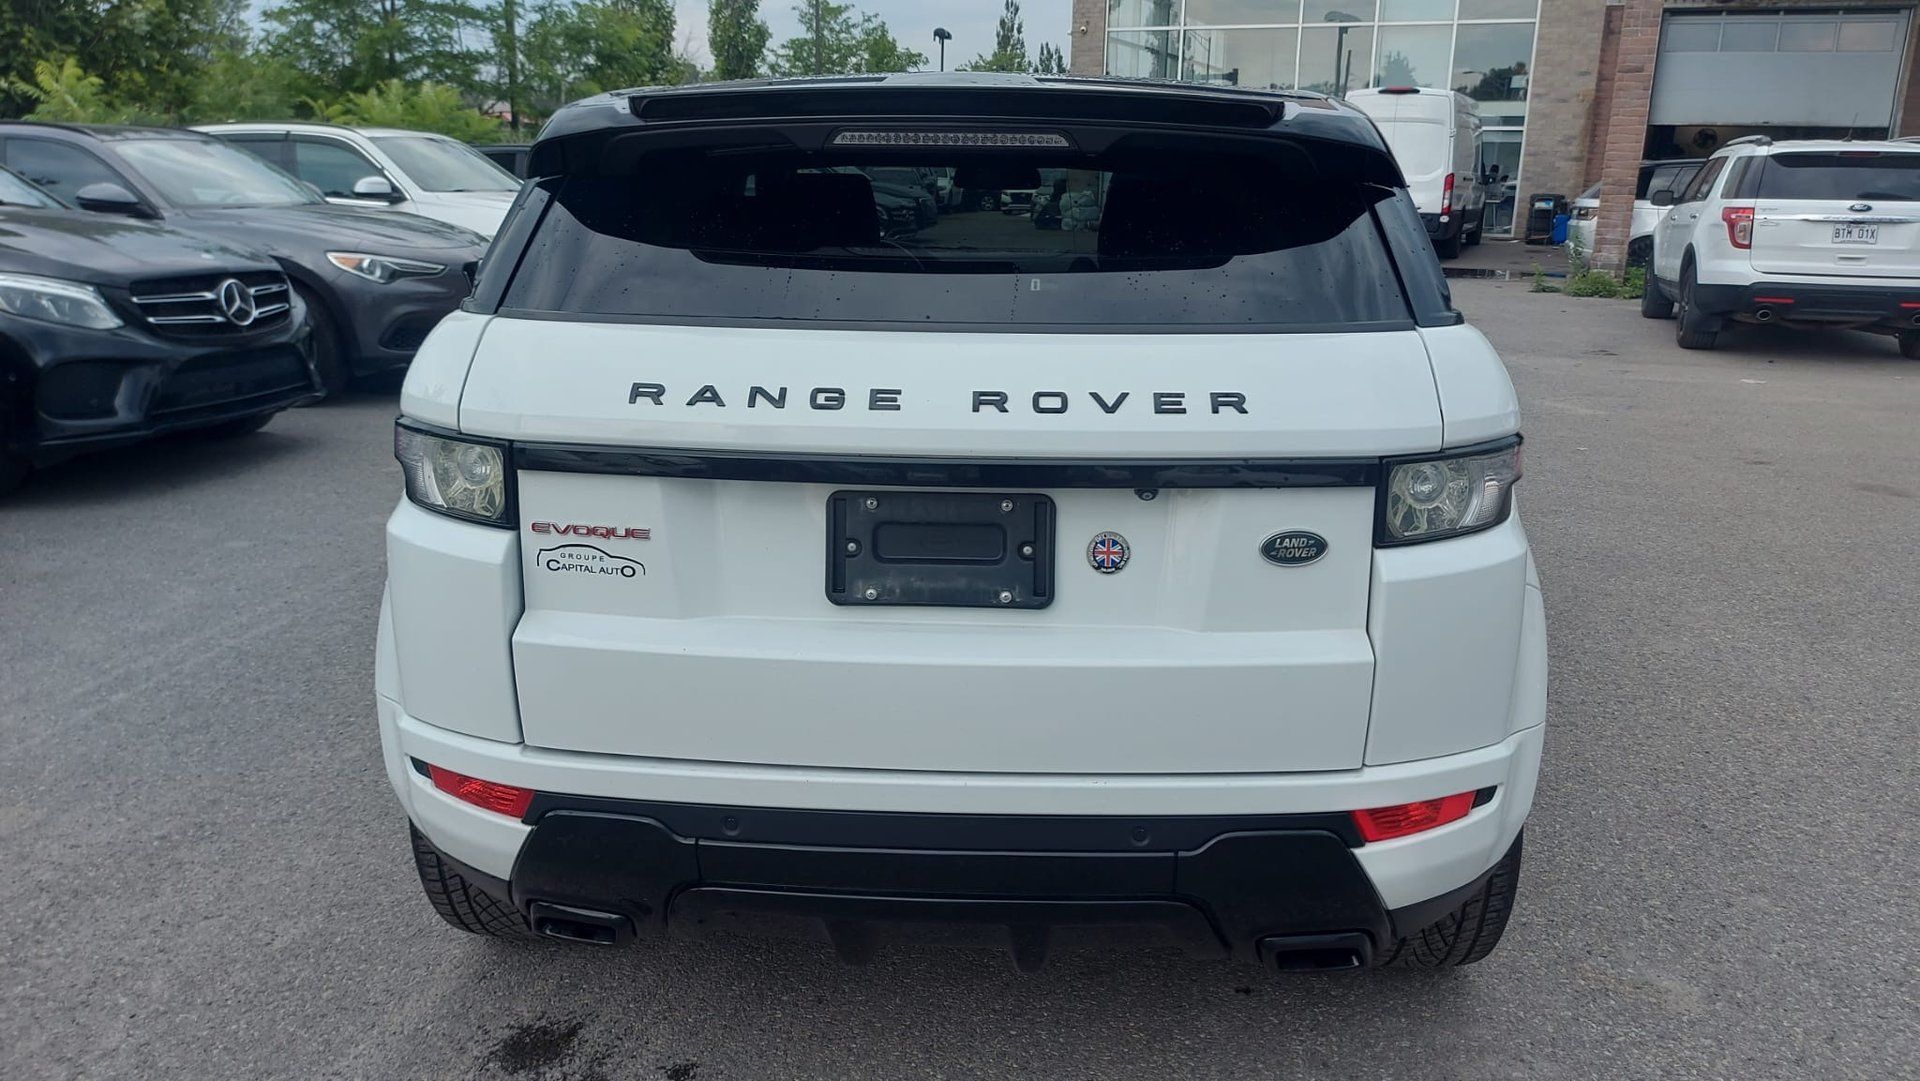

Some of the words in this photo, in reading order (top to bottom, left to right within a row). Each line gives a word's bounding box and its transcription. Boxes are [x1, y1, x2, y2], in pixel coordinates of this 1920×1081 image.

[1834, 228, 1853, 239] BTM
[628, 382, 902, 411] RANGE
[971, 390, 1249, 415] ROVER
[531, 522, 651, 540] EVOQUE
[1275, 538, 1308, 548] LAND
[560, 552, 605, 562] GROUPE
[1277, 547, 1317, 558] ROVER
[546, 559, 597, 574] CAPITAL
[598, 565, 636, 578] AUTO
